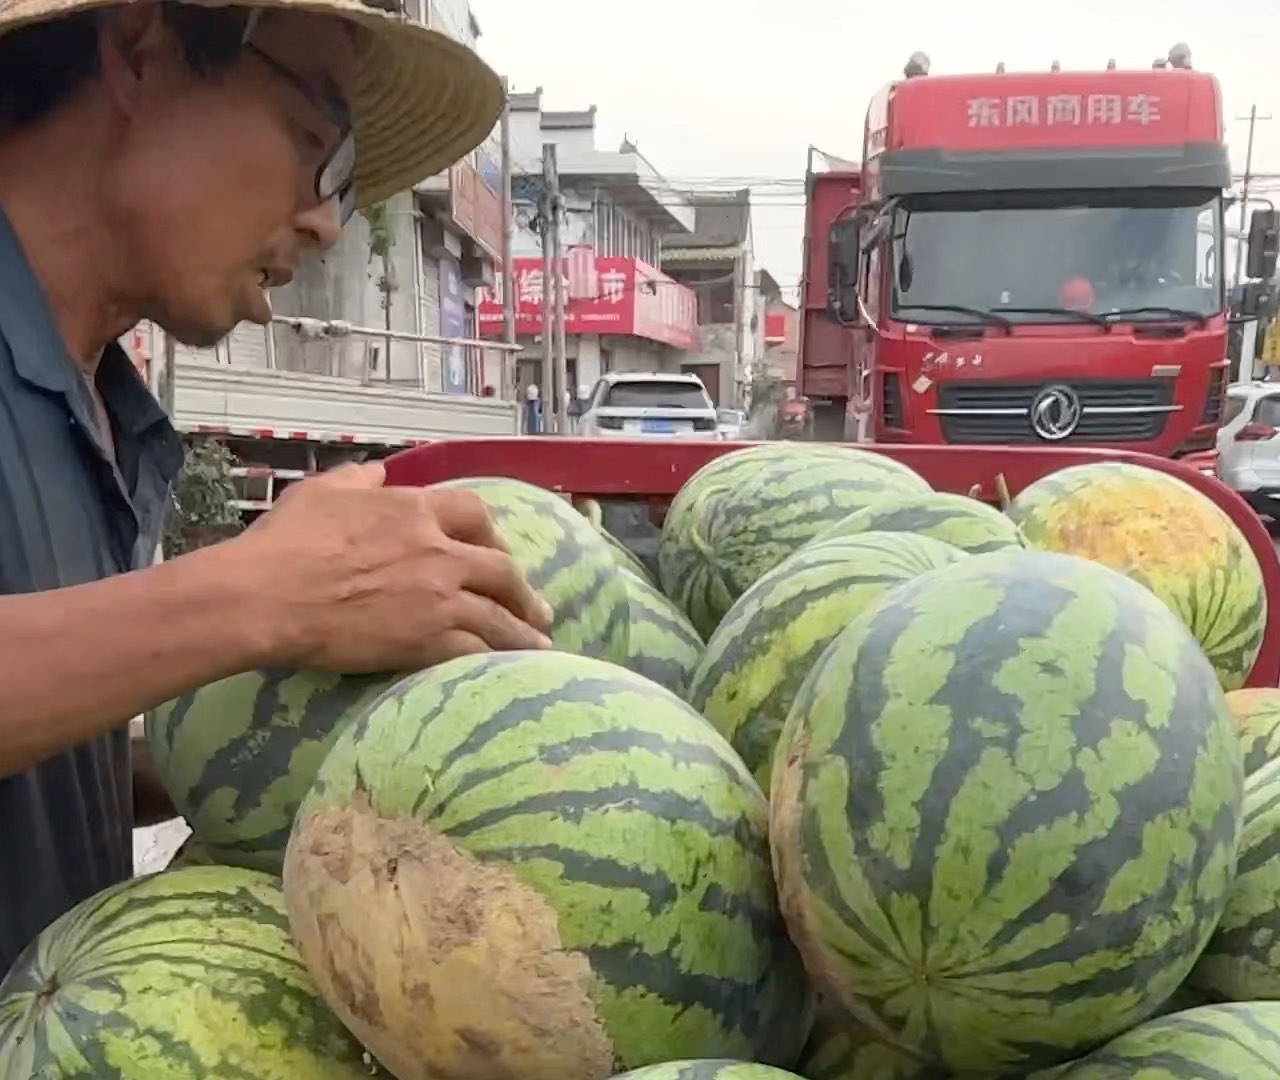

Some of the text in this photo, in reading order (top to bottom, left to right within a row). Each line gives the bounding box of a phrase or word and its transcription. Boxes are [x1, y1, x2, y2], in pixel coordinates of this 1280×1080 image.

[968, 94, 1160, 128] 东风商用车
